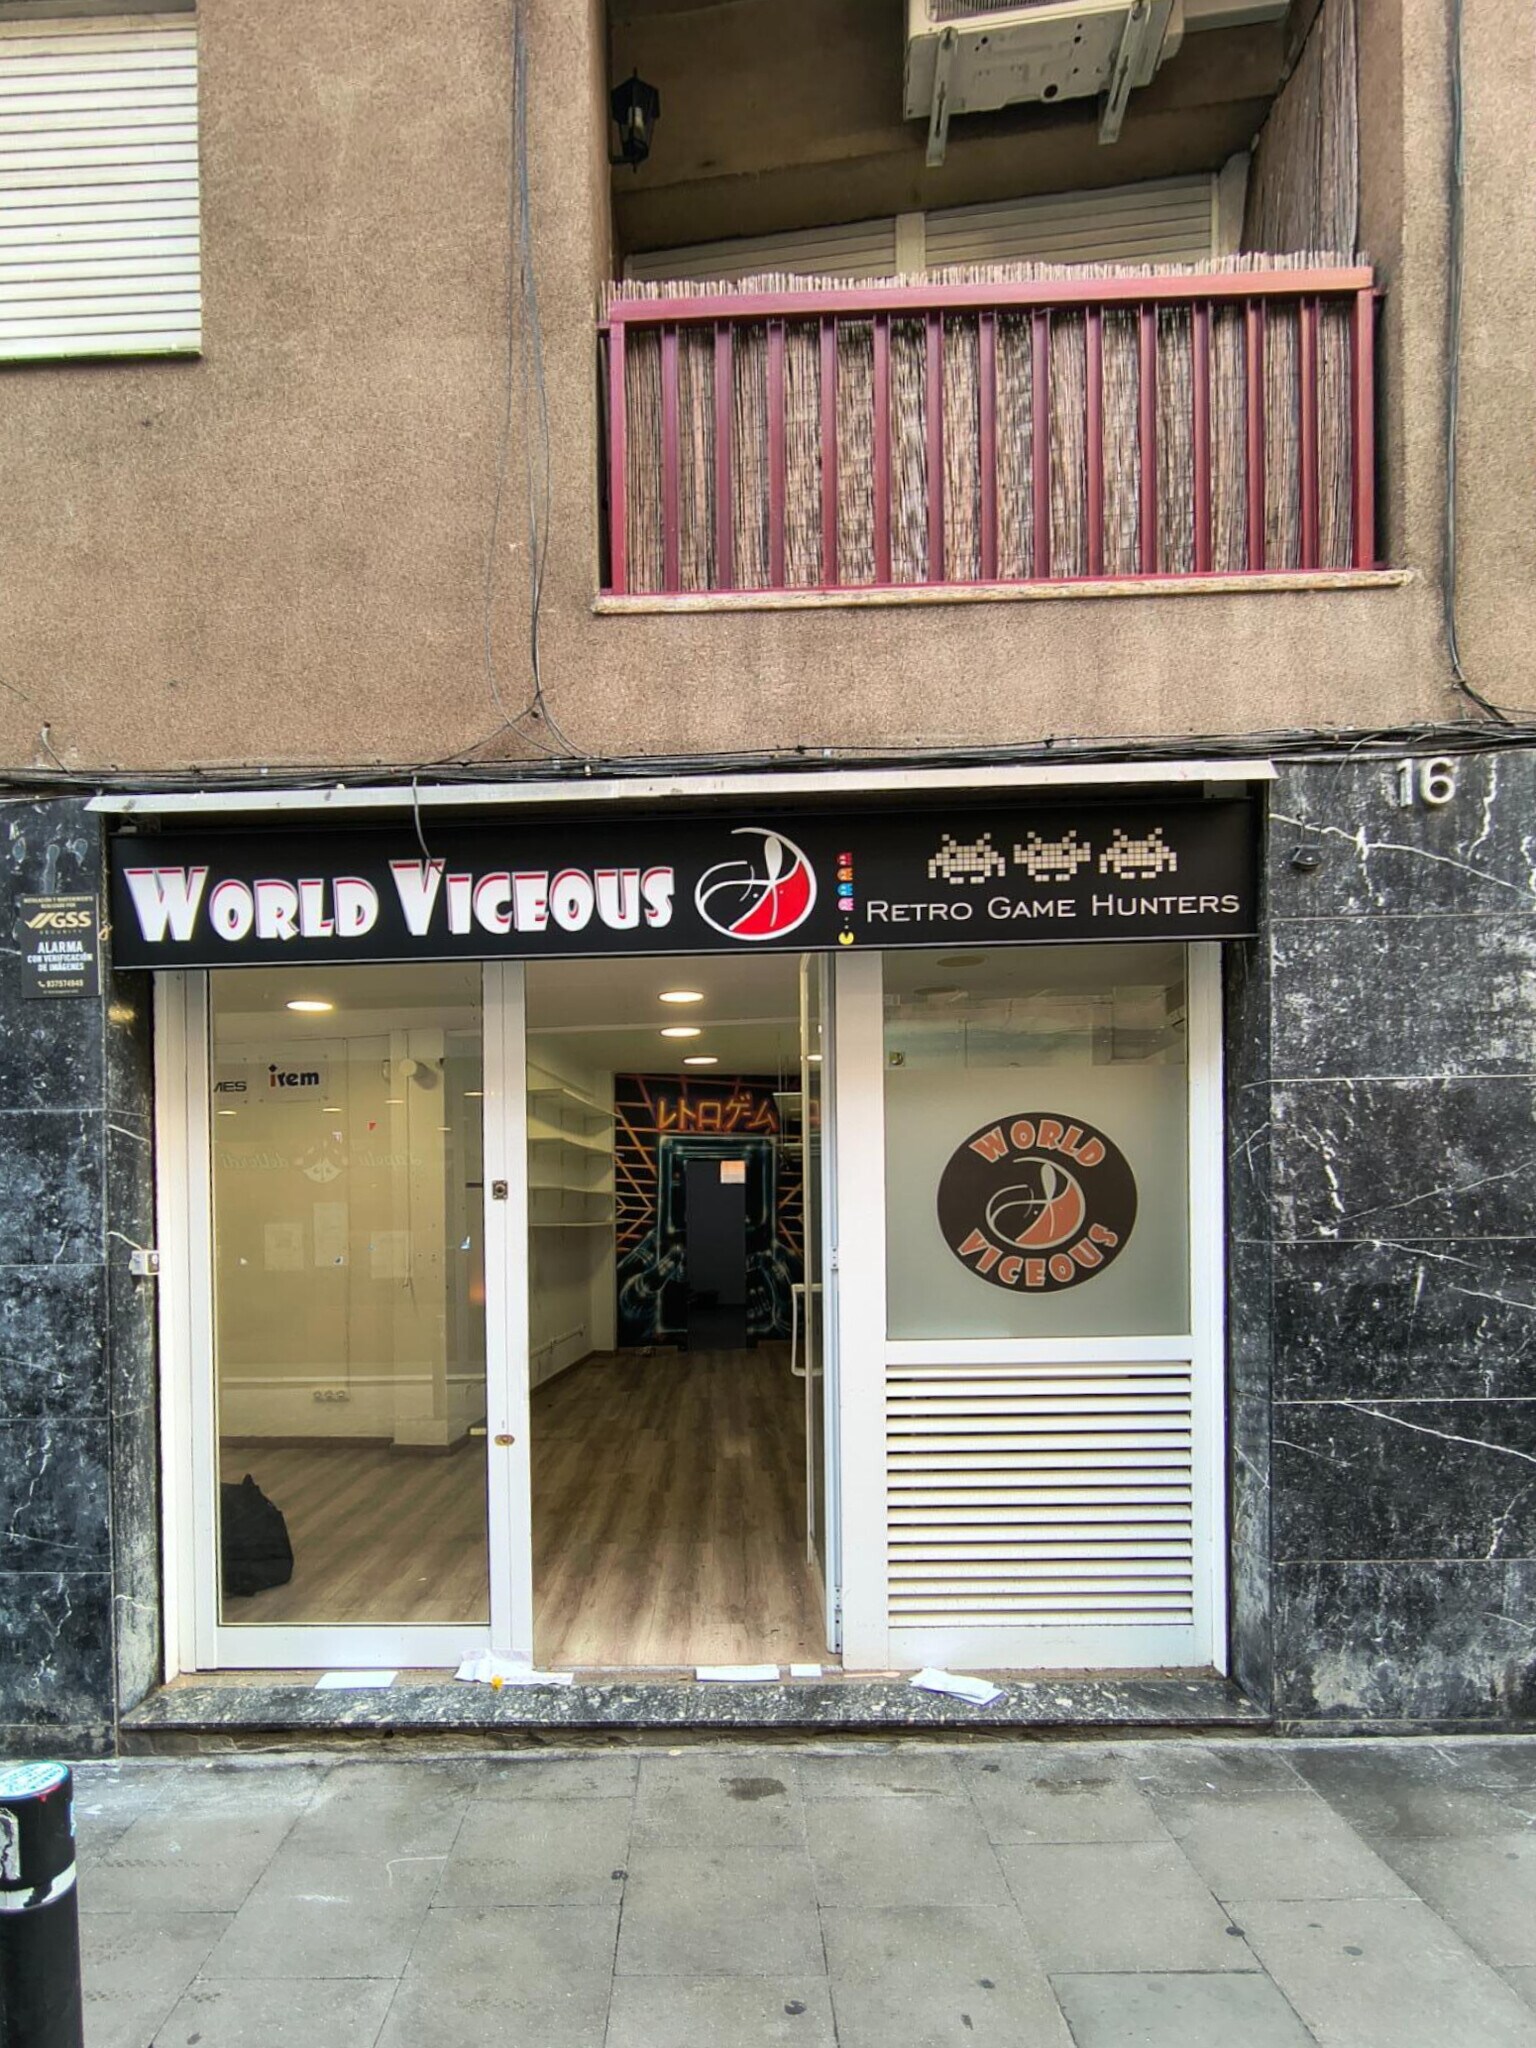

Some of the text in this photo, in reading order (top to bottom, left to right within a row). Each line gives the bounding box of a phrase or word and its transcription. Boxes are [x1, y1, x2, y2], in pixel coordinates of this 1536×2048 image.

[1396, 757, 1456, 807] 16
[37, 940, 84, 953] ALARMA
[268, 1064, 320, 1087] irem
[968, 1119, 1106, 1167] WORLD
[957, 1223, 1118, 1286] VICEOUS
